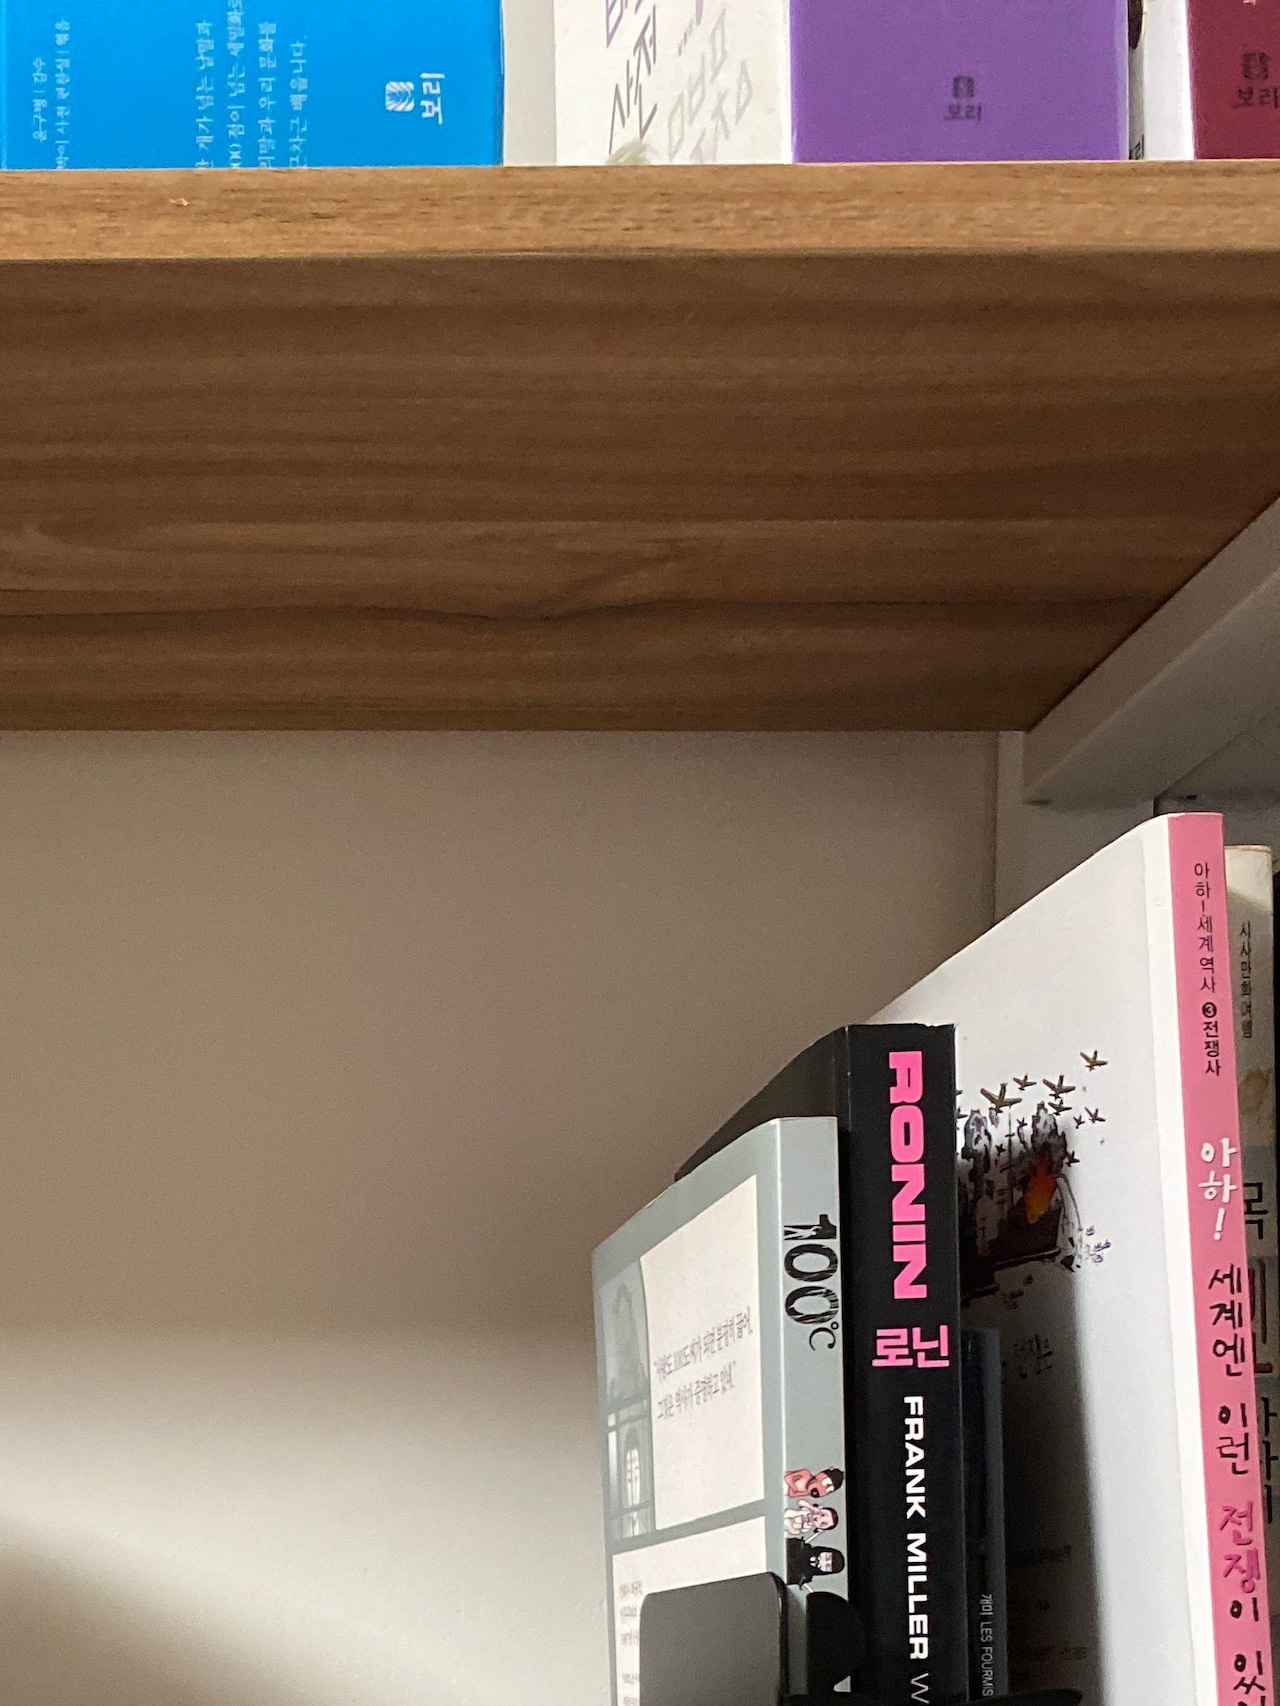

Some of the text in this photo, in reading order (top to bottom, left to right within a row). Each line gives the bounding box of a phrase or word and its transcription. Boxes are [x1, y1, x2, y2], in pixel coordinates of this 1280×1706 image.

[31, 56, 48, 85] 감수
[258, 76, 277, 111] 우리
[420, 73, 446, 126] 보리
[944, 103, 982, 122] 보리
[1233, 88, 1279, 111] 보리
[1193, 861, 1212, 917] 아하!
[1202, 1020, 1222, 1077] 전쟁사
[888, 1051, 928, 1299] RONIN
[1198, 1136, 1238, 1241] 아하!
[871, 1324, 950, 1369] 로닌
[1208, 1264, 1247, 1377] 세계엔
[903, 1395, 927, 1519] FRANK
[1216, 1402, 1249, 1475] 이런
[1219, 1500, 1261, 1622] 전쟁이
[906, 1532, 930, 1660] MILLER
[980, 1620, 993, 1643] LES
[981, 1646, 995, 1698] FOURMIS
